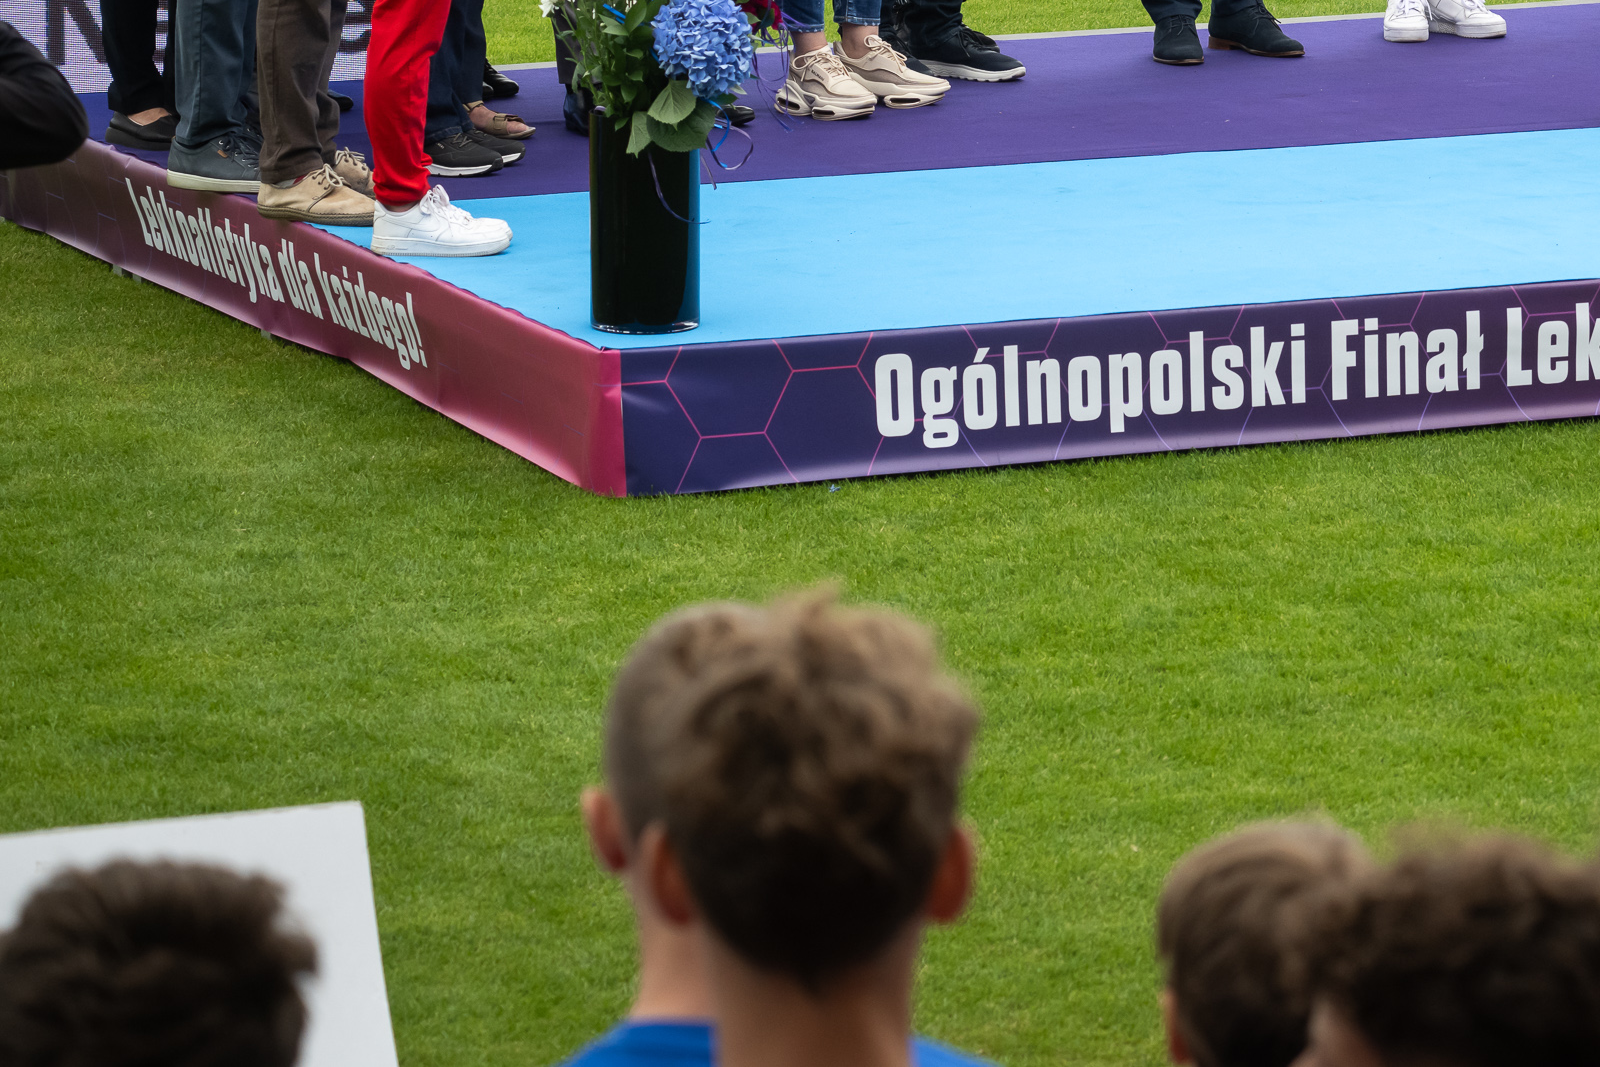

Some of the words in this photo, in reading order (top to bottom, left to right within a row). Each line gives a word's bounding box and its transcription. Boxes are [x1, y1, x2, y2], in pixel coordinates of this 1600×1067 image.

[125, 177, 285, 303] Lekkoatletyka
[277, 238, 324, 320] dla
[313, 251, 428, 371] każdego!
[874, 323, 1306, 449] Ogólnopolski
[1330, 310, 1484, 401] Finał
